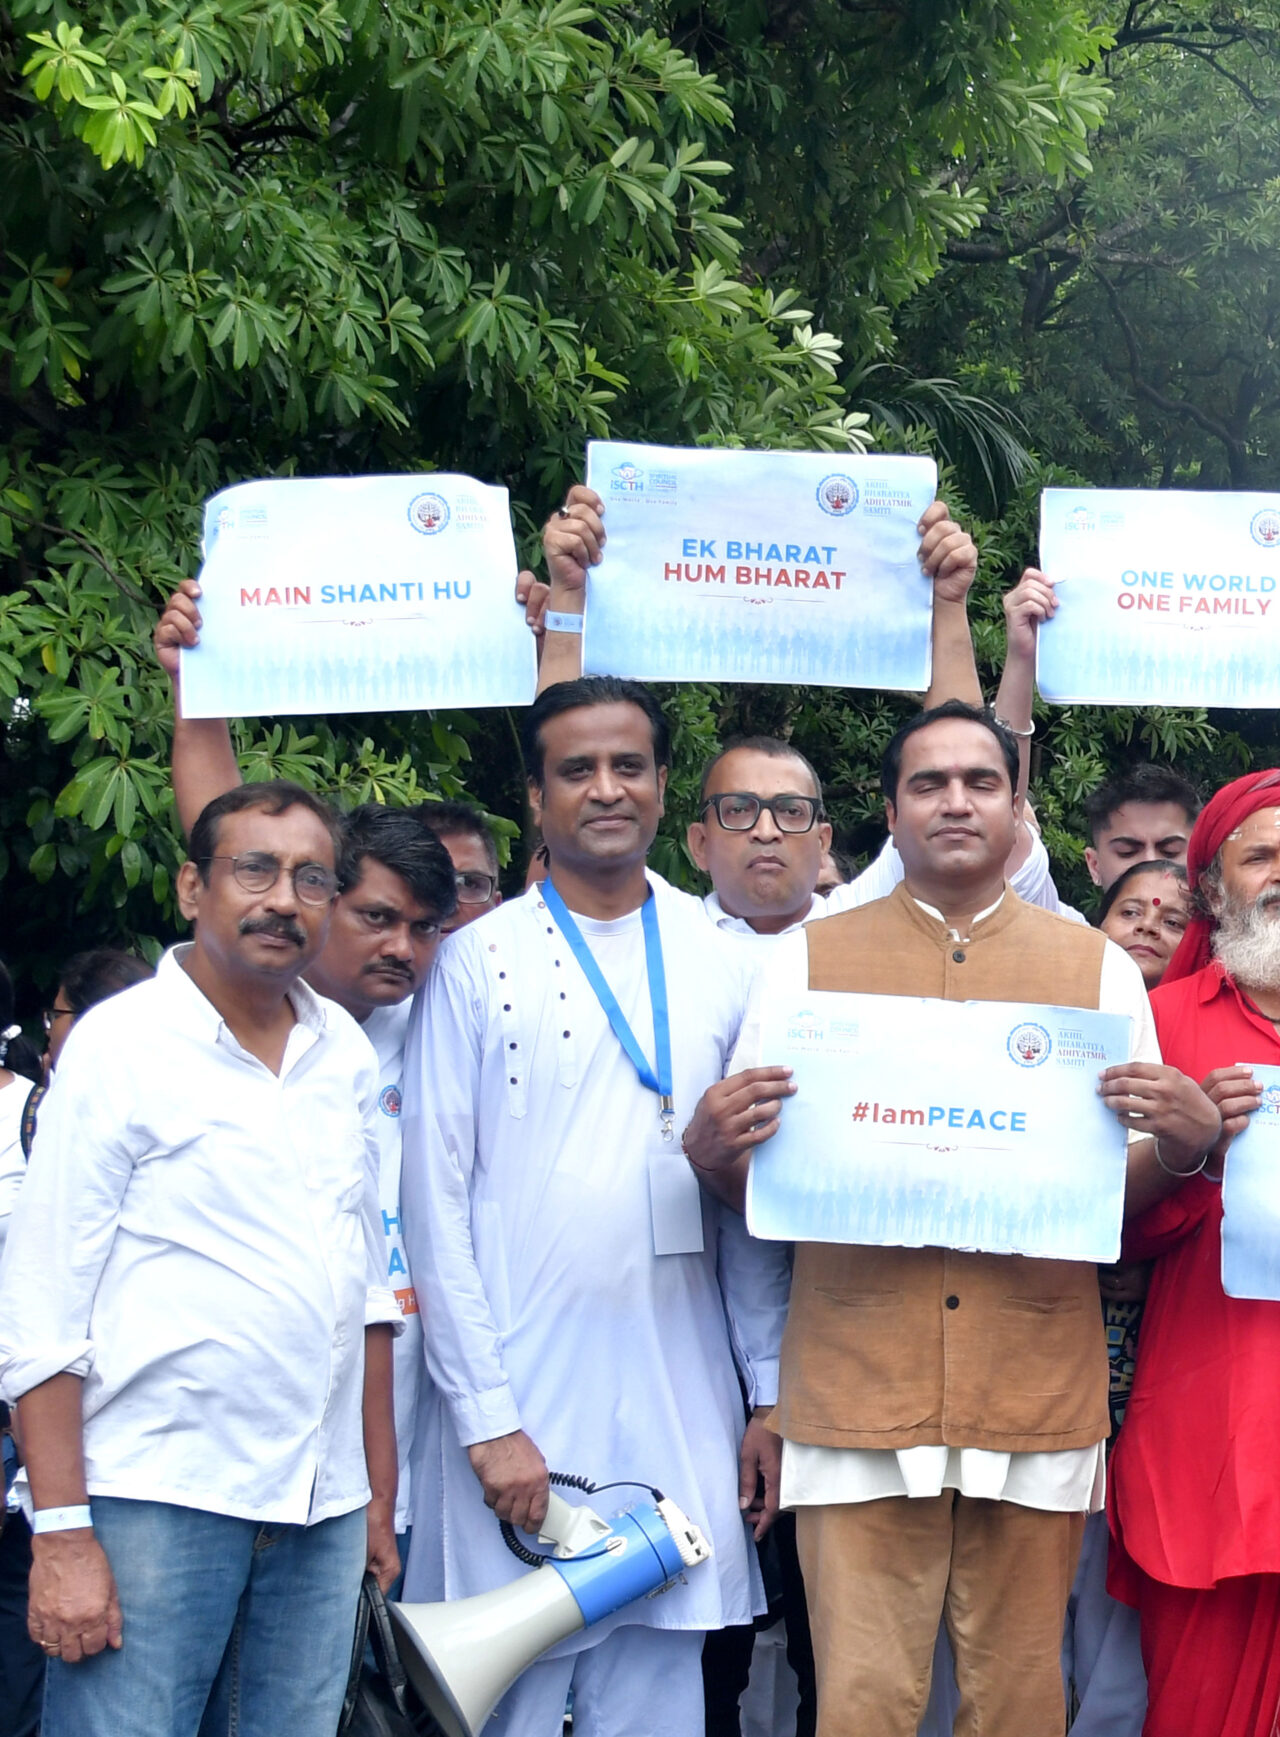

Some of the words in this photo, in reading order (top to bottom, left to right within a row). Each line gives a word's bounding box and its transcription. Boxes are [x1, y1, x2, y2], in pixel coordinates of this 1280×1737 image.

[683, 538, 717, 559] EK
[726, 541, 837, 565] BHARAT
[664, 563, 725, 584] HUM
[735, 566, 847, 590] BHARAT
[1121, 570, 1174, 589] ONE
[1183, 573, 1276, 593] WORLD
[240, 586, 311, 606] MAIN
[321, 582, 423, 604] SHANTI
[434, 580, 472, 599] HU
[1117, 592, 1170, 612] ONE
[1179, 596, 1272, 616] FAMILY
[852, 1102, 1027, 1132] #IamPEACE
